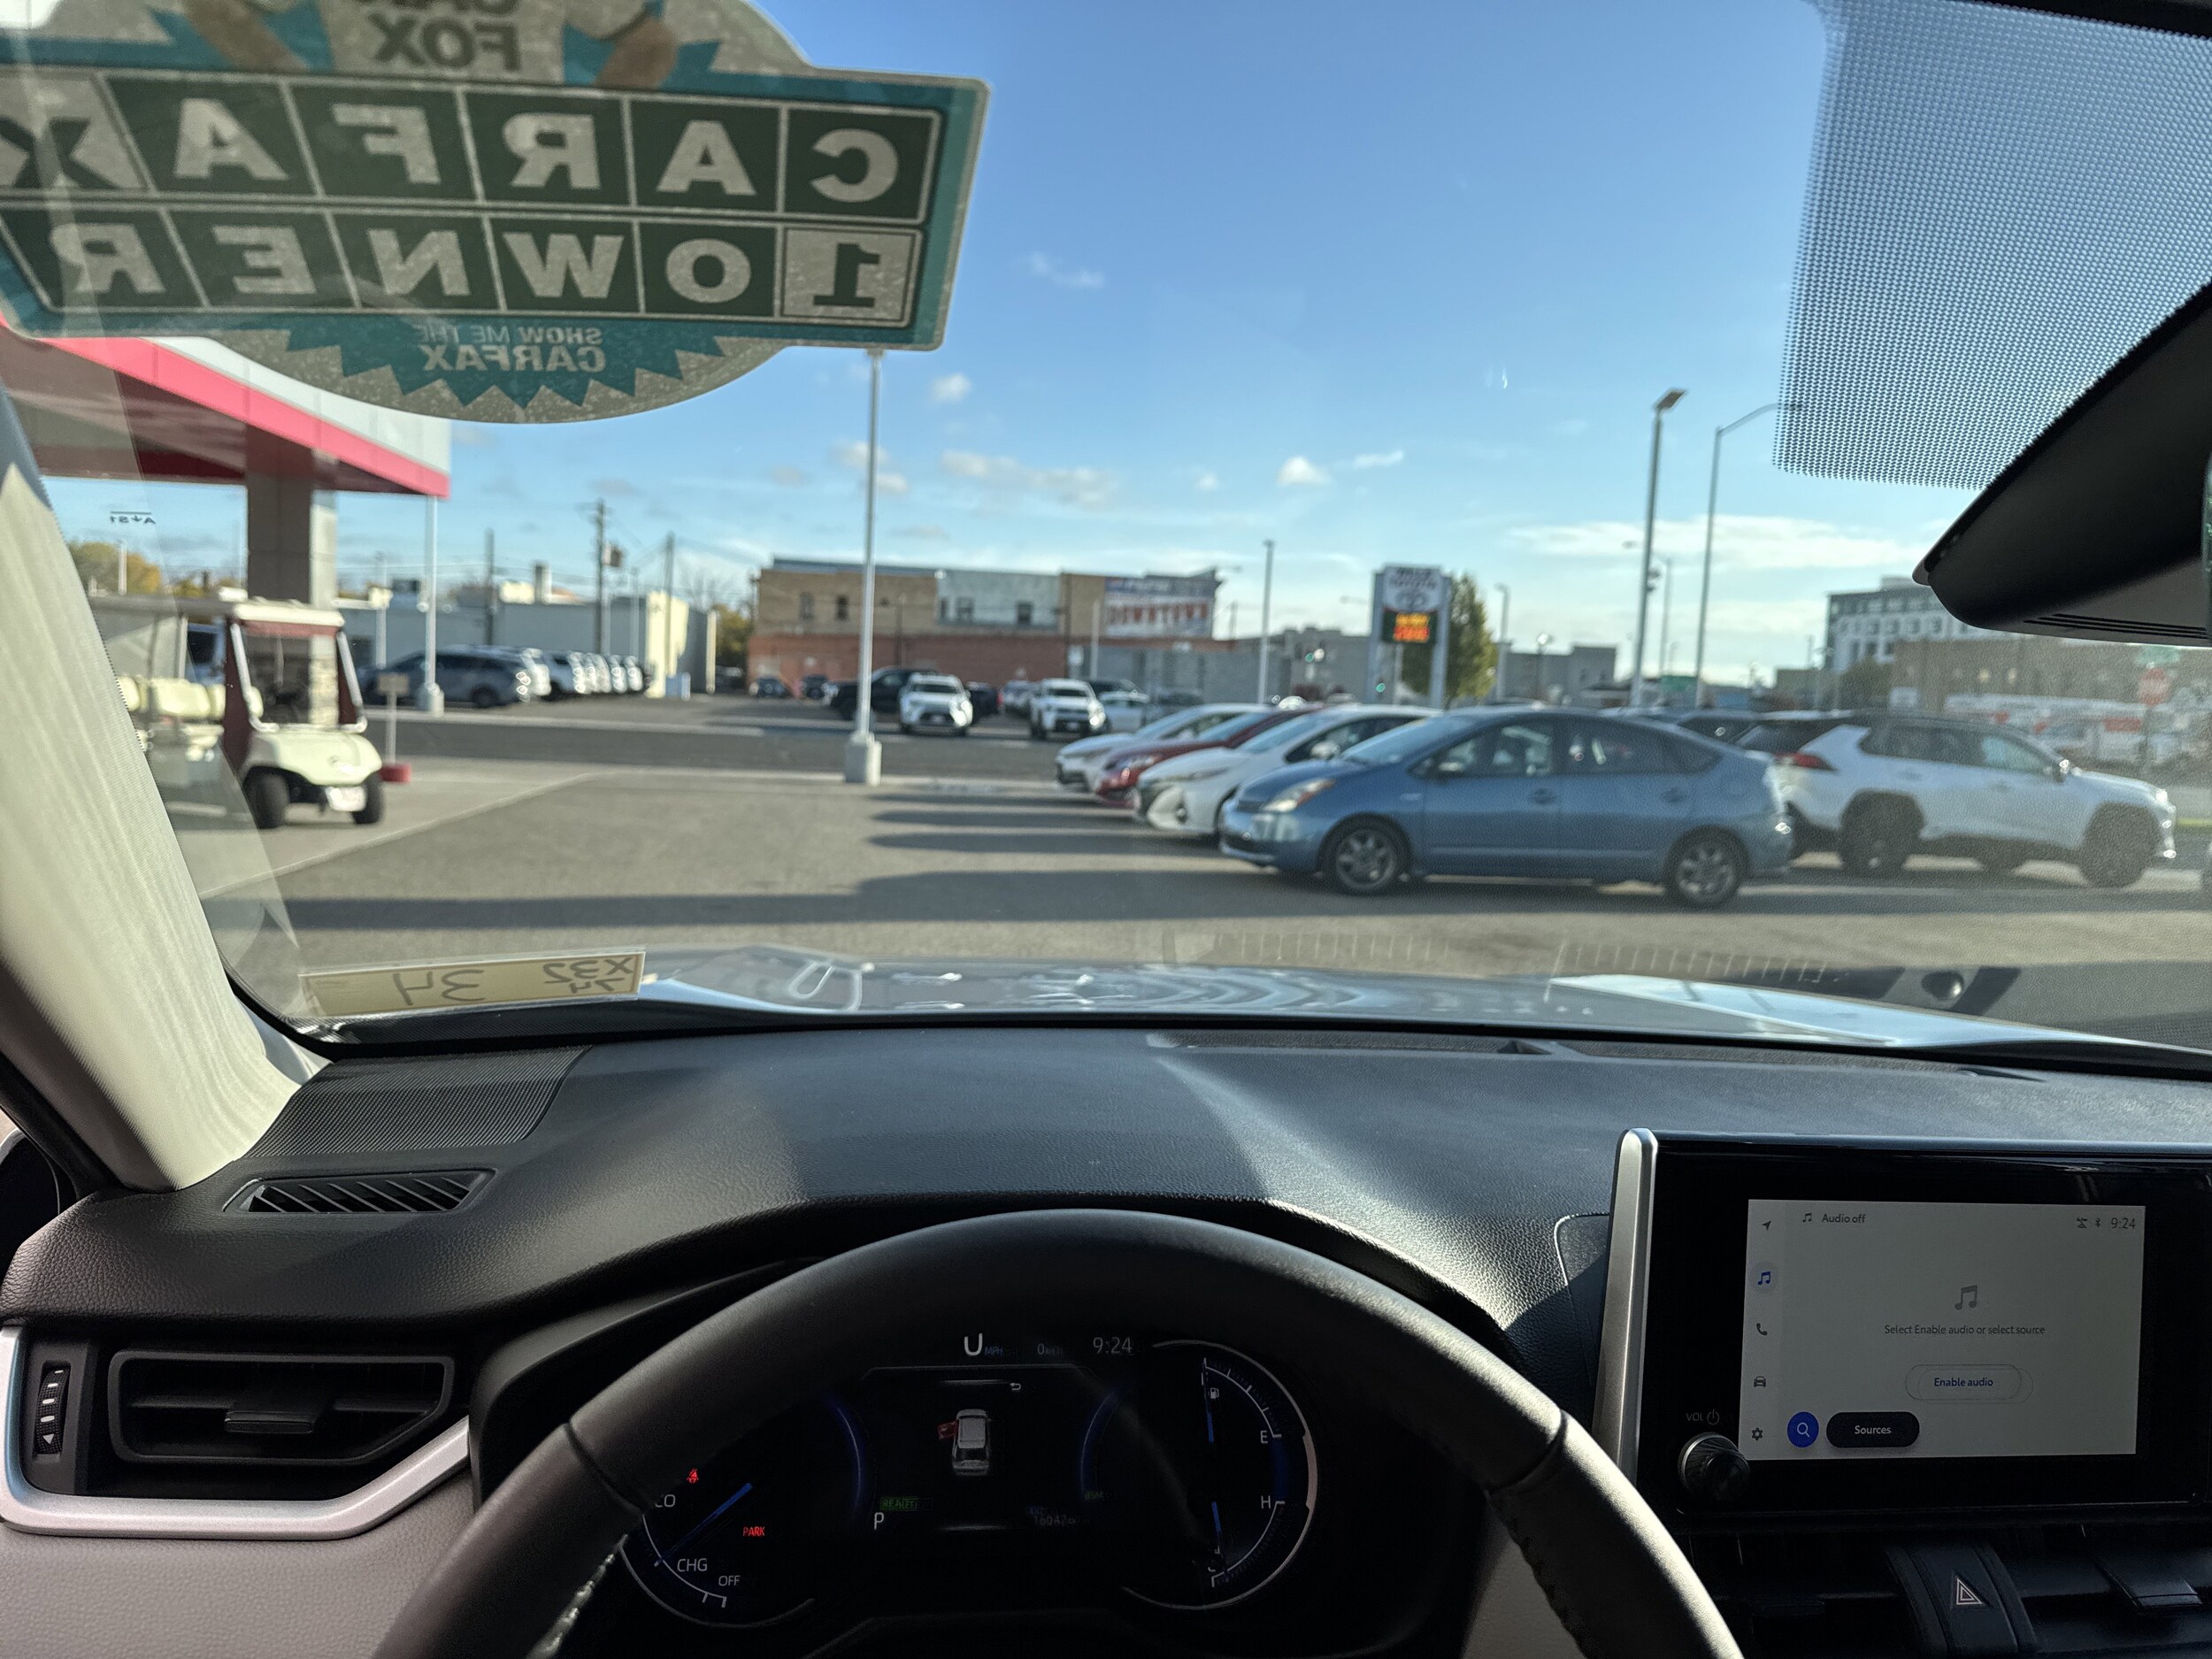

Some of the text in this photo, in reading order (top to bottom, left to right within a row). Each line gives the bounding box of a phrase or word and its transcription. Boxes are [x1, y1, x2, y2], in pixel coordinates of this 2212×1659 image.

[1822, 1213, 1866, 1224] Audio off
[2111, 1217, 2136, 1229] 9:24
[1885, 1325, 1912, 1334] Select
[1915, 1325, 1947, 1334] Enable
[1948, 1325, 1974, 1334] audio
[1987, 1325, 2014, 1334] select
[1093, 1336, 1133, 1355] 9:24
[1934, 1378, 1993, 1386] Enable audio
[1686, 1412, 1705, 1421] VOL
[1854, 1425, 1892, 1435] Sources
[1260, 1430, 1269, 1444] E
[1261, 1495, 1271, 1509] H
[873, 1511, 885, 1531] P
[742, 1525, 765, 1537] PARK
[677, 1558, 708, 1572] CHG
[718, 1575, 741, 1586] OFF
